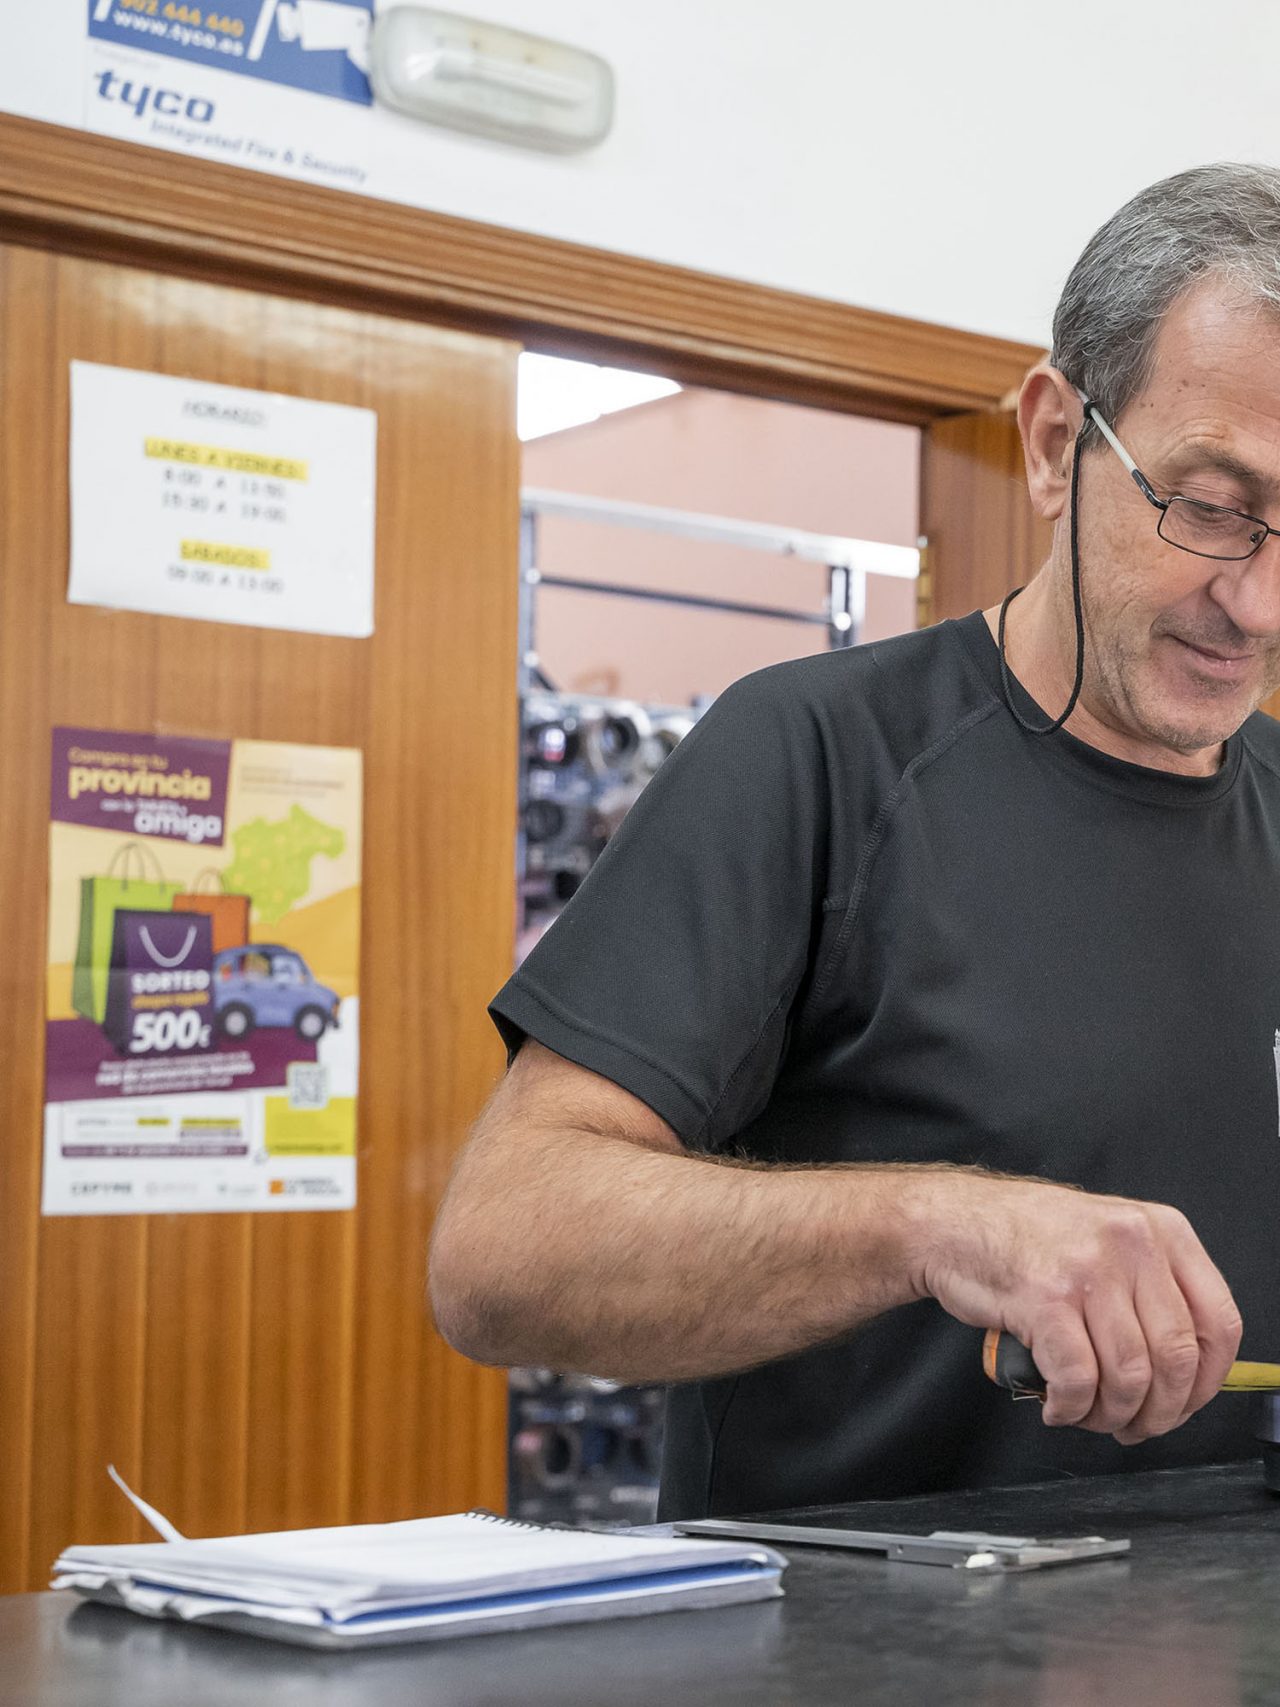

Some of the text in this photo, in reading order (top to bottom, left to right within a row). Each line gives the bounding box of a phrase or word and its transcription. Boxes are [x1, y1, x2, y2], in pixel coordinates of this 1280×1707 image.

[113, 9, 244, 57] www.tyco.es
[95, 70, 215, 123] tyco
[151, 118, 242, 152] Integrated
[282, 151, 294, 164] &
[68, 766, 211, 800] provincia
[134, 814, 222, 843] amiga
[131, 969, 210, 994] SORTEO
